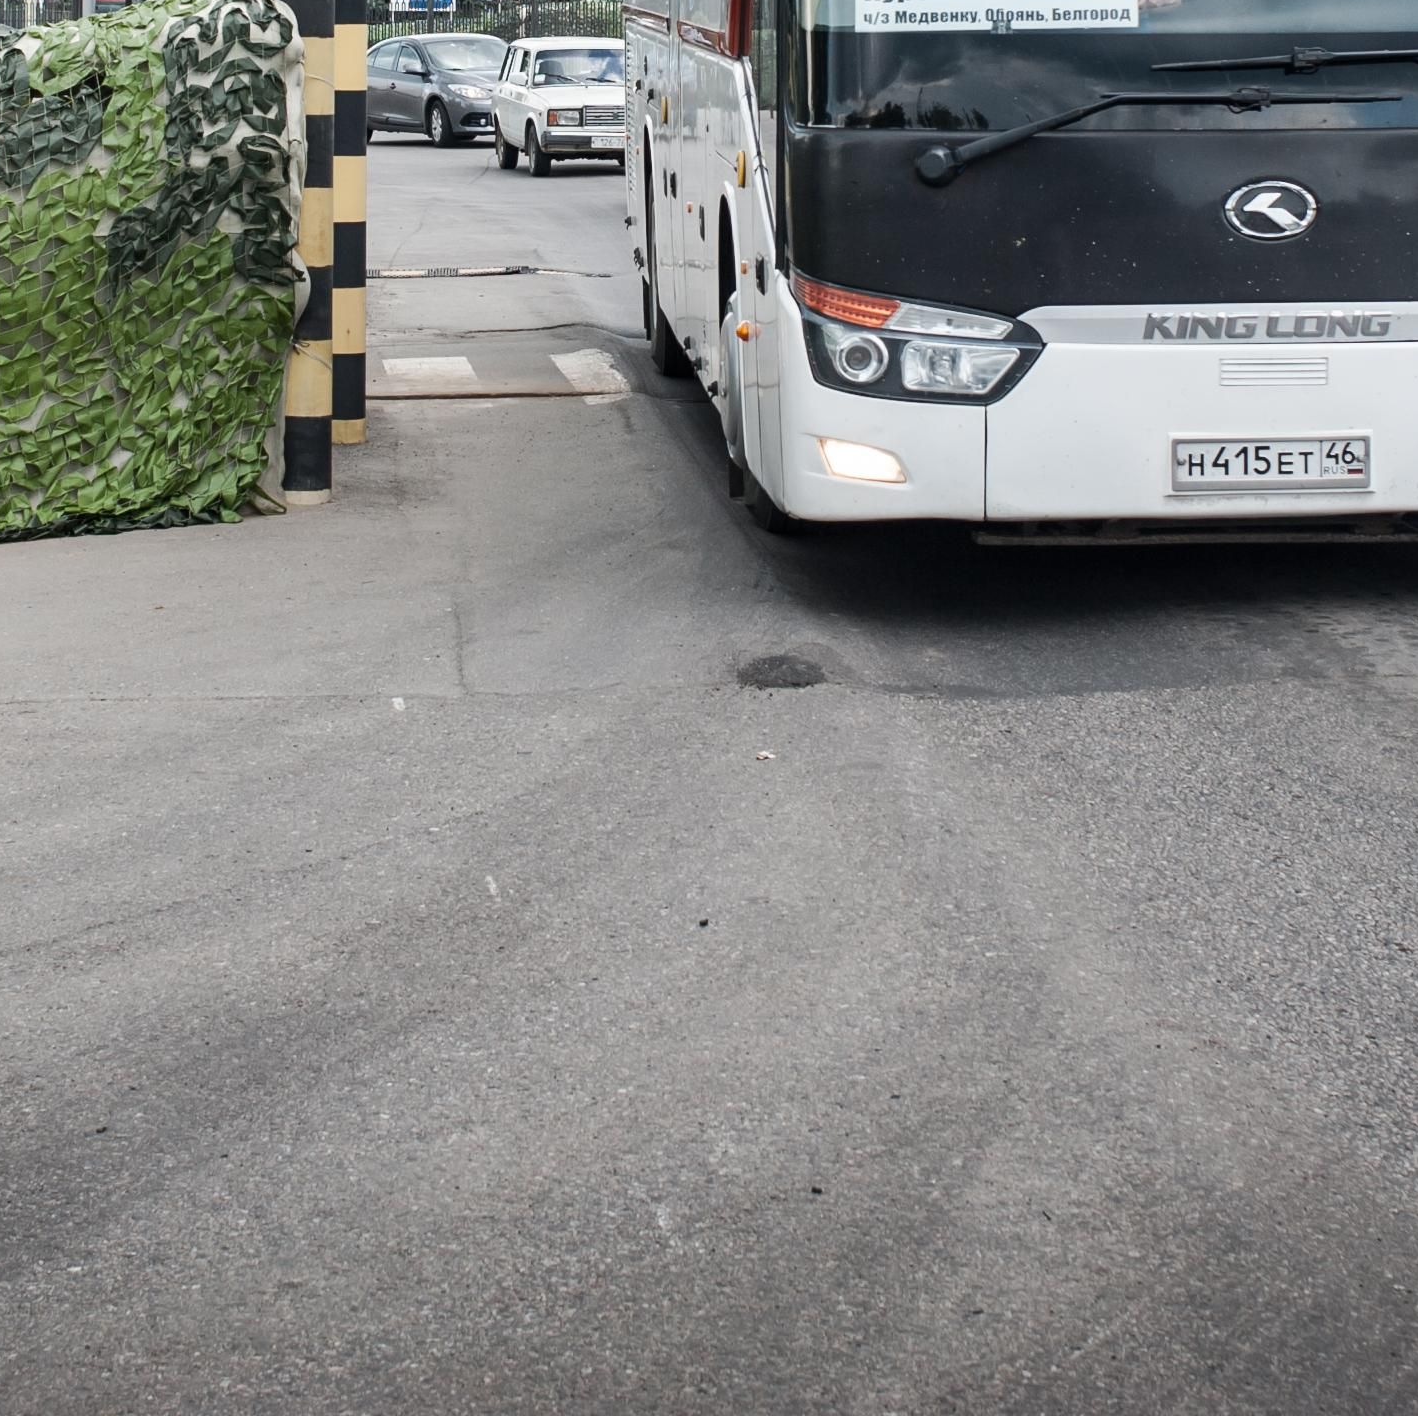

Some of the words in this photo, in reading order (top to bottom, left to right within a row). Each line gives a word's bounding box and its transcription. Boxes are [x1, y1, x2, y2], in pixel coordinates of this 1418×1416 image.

[864, 13, 889, 25] ч/з
[894, 9, 981, 26] Медвенку,
[1052, 8, 1131, 23] Белгород
[1143, 312, 1256, 340] KING
[1266, 311, 1392, 339] LONG
[1326, 442, 1355, 465] 46
[1324, 466, 1346, 474] RUS
